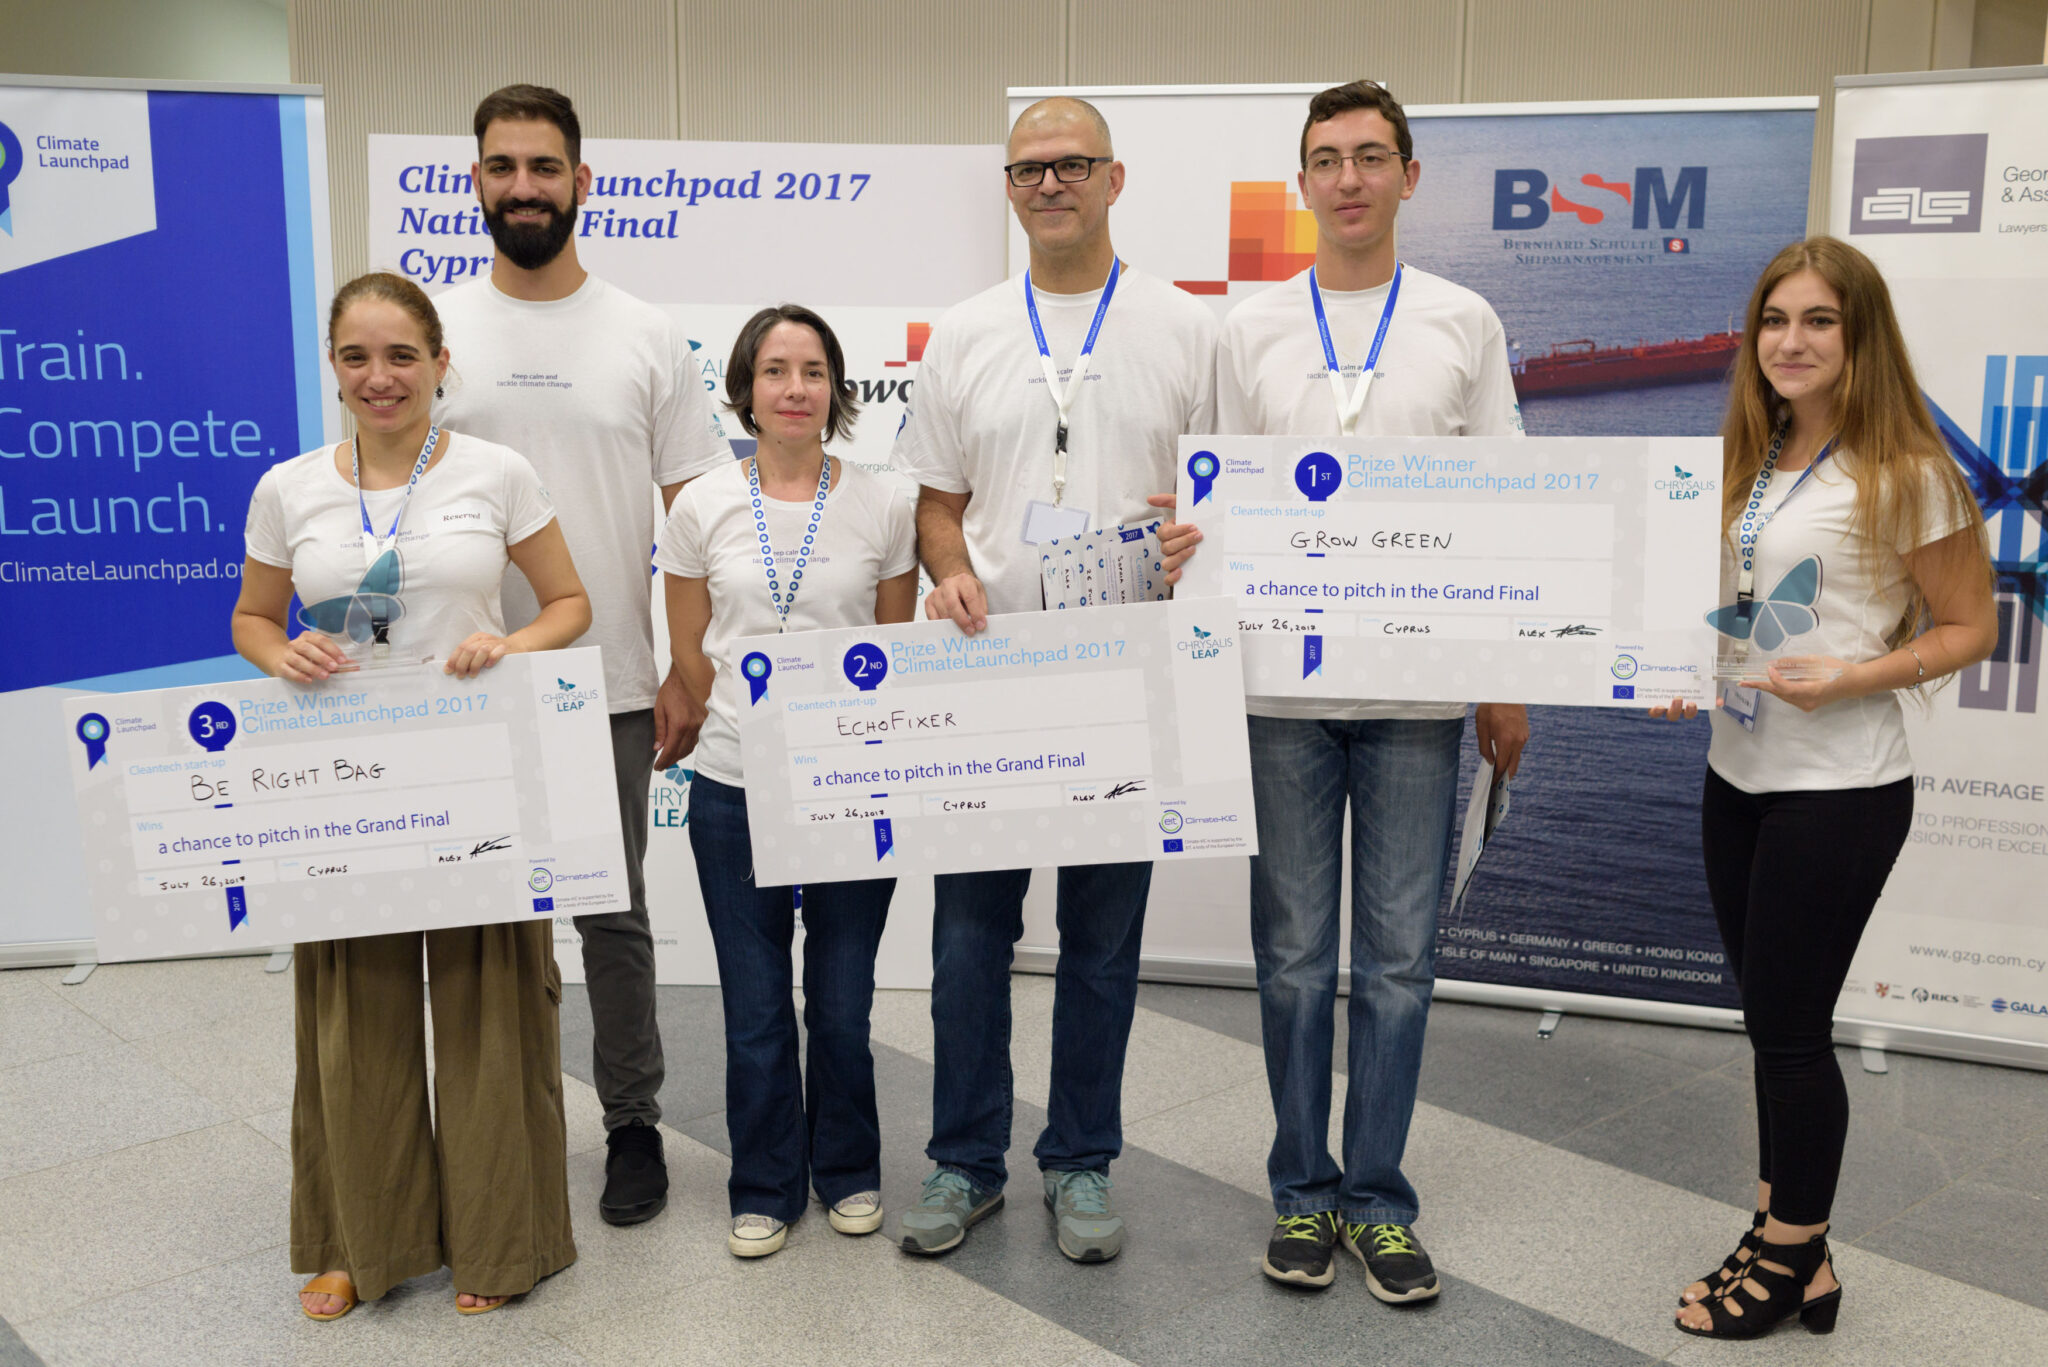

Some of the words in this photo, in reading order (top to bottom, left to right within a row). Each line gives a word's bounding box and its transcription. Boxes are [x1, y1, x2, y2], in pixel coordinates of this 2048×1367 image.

[37, 135, 99, 151] Climate
[39, 153, 129, 172] Launchpad
[774, 172, 871, 202] 2017
[1492, 166, 1708, 230] BSM
[2001, 186, 2014, 203] &
[579, 209, 680, 239] Final
[399, 248, 494, 284] Cypr
[546, 381, 572, 389] change
[1348, 454, 1395, 471] Prize
[1403, 455, 1476, 472] Winner
[1226, 466, 1264, 475] Launchpad
[1347, 471, 1536, 493] ClimateLaunchpad
[1544, 474, 1599, 490] 2017
[1654, 480, 1715, 491] CHRYSALIS
[1669, 491, 1699, 500] LEAP
[443, 513, 481, 522] Reserved
[1231, 506, 1282, 516] Cleantech
[1285, 507, 1325, 518] start-up
[1125, 531, 1138, 540] 2017
[1290, 531, 1358, 548] GROW
[1372, 531, 1452, 549] GREEN
[1229, 561, 1254, 571] Wins
[1246, 585, 1255, 596] a
[1259, 580, 1318, 597] chance
[1322, 583, 1339, 597] to
[1344, 582, 1386, 600] pitch
[1391, 584, 1407, 598] in
[1410, 584, 1438, 599] the
[1443, 584, 1494, 600] Grand
[1499, 585, 1539, 600] Final
[1238, 620, 1264, 631] JULY
[1383, 622, 1431, 634] CYPRUS
[891, 640, 936, 658] Prize
[942, 636, 1011, 653] Winner
[1177, 637, 1233, 651] CHRYSALIS
[776, 656, 802, 664] Climate
[893, 645, 1068, 674] ClimateLaunchpad
[1075, 640, 1126, 659] 2017
[1191, 648, 1219, 659] LEAP
[778, 662, 814, 671] Launchpad
[1617, 663, 1631, 671] eit
[1640, 664, 1698, 672] Climate-KIC
[541, 689, 599, 704] CHRYSALIS
[240, 698, 288, 716] Prize
[294, 692, 368, 711] Winner
[556, 701, 585, 712] LEAP
[788, 698, 837, 712] Cleantech
[839, 696, 877, 708] start-up
[242, 700, 429, 734] ClimateLaunchpad
[436, 694, 488, 715] 2017
[115, 716, 142, 726] Climate
[116, 723, 156, 733] Launchpad
[794, 754, 818, 765] Wins
[128, 762, 182, 775] Cleantech
[184, 758, 226, 771] start-up
[812, 775, 822, 786] a
[825, 770, 880, 786] chance
[884, 767, 901, 781] to
[904, 763, 944, 783] pitch
[948, 762, 962, 776] in
[966, 760, 992, 774] the
[996, 754, 1044, 772] Grand
[1048, 752, 1085, 769] Final
[190, 774, 229, 800] BE
[252, 768, 320, 792] RIGHT
[334, 759, 386, 781] BAG
[1942, 778, 2045, 802] AVERAGE
[943, 801, 986, 812] CYPRUS
[810, 813, 836, 821] JULY
[1164, 817, 1177, 825] eit
[1185, 815, 1238, 824] Climate-KIC
[1916, 812, 1938, 827] TO
[136, 822, 164, 832] Wins
[158, 842, 168, 854] a
[172, 837, 232, 853] chance
[236, 832, 253, 846] to
[258, 826, 300, 848] pitch
[304, 825, 320, 839] in
[324, 821, 352, 837] the
[356, 815, 406, 835] Grand
[410, 810, 450, 828] Final
[1958, 834, 1993, 850] FOR
[307, 864, 348, 877] CYPRUS
[555, 870, 608, 882] Climate-KIC
[160, 881, 189, 891] JULY
[534, 874, 548, 885] eit
[1448, 927, 1497, 942] CYPRUS
[1508, 934, 1570, 948] GERMANY
[1582, 940, 1633, 955] GREECE
[1645, 946, 1683, 960] HONG
[1686, 950, 1724, 965] KONG
[1909, 944, 2046, 972] www.gzg.com.cy
[1442, 947, 1467, 959] ISLE
[1470, 950, 1487, 960] OF
[1489, 952, 1517, 963] MAN
[1528, 955, 1600, 972] SINGAPORE
[1612, 964, 1658, 978] UNITED
[1660, 968, 1722, 984] KINGDOM
